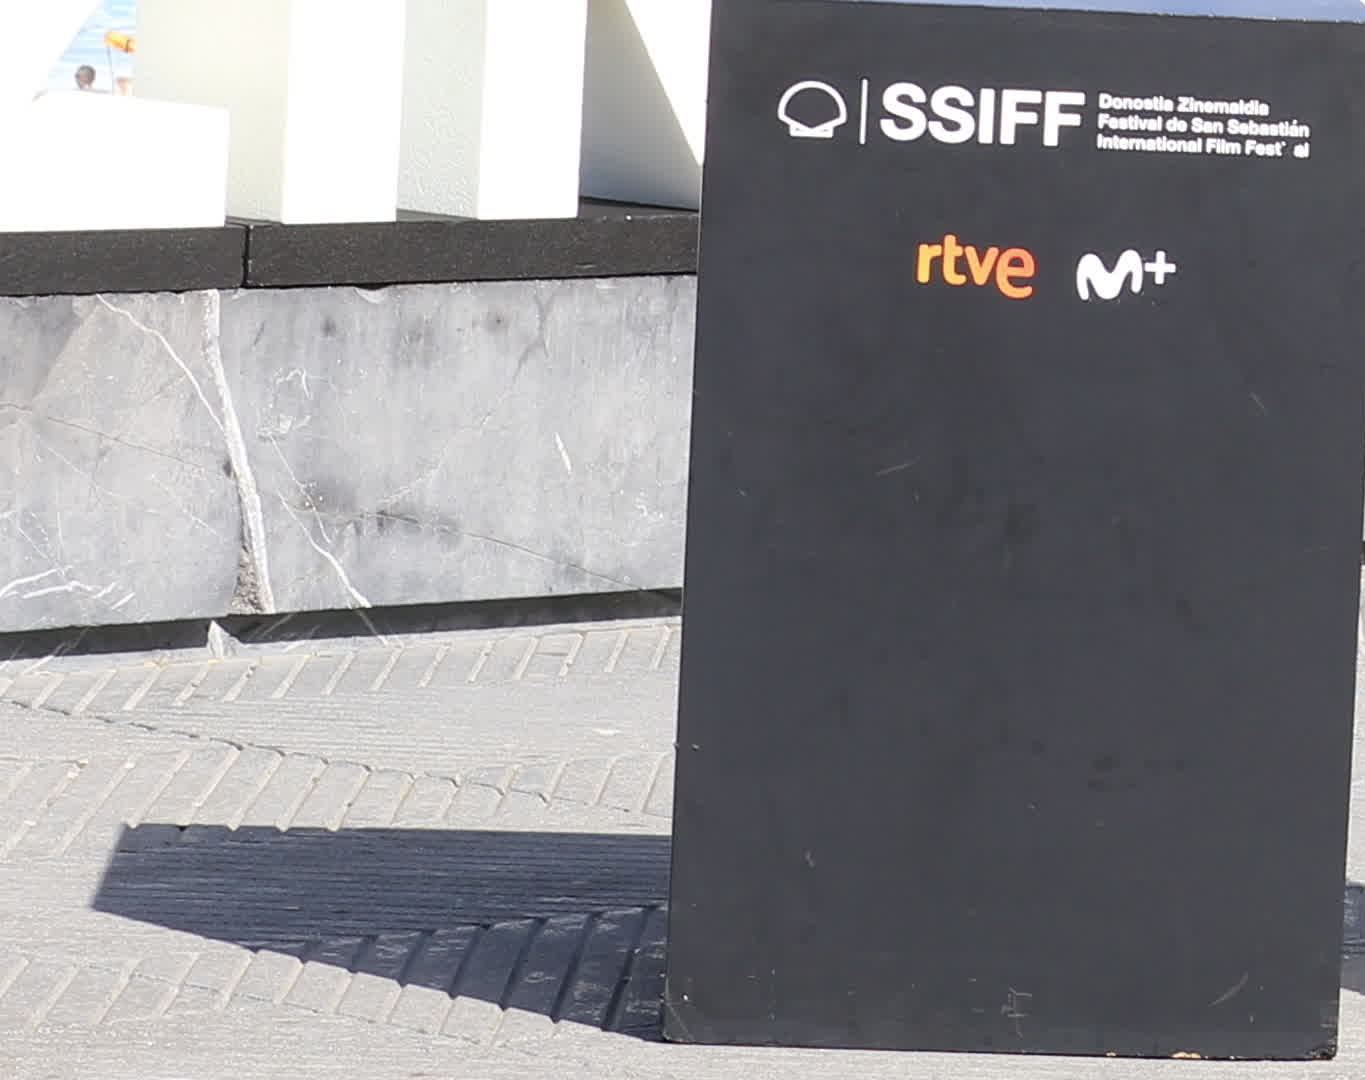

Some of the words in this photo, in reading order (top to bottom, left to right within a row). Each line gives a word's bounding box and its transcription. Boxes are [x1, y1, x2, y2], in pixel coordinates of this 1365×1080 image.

[879, 81, 1085, 147] SSIFF
[1098, 93, 1175, 112] Donostia
[1177, 96, 1270, 116] Zinemaldia
[1097, 113, 1163, 131] Festival
[1166, 117, 1188, 132] de
[1191, 117, 1224, 134] San
[1227, 119, 1310, 137] Sebastián
[1097, 134, 1203, 153] International
[1206, 138, 1241, 155] Film
[1245, 140, 1310, 158] Festal
[916, 234, 1036, 299] rtve
